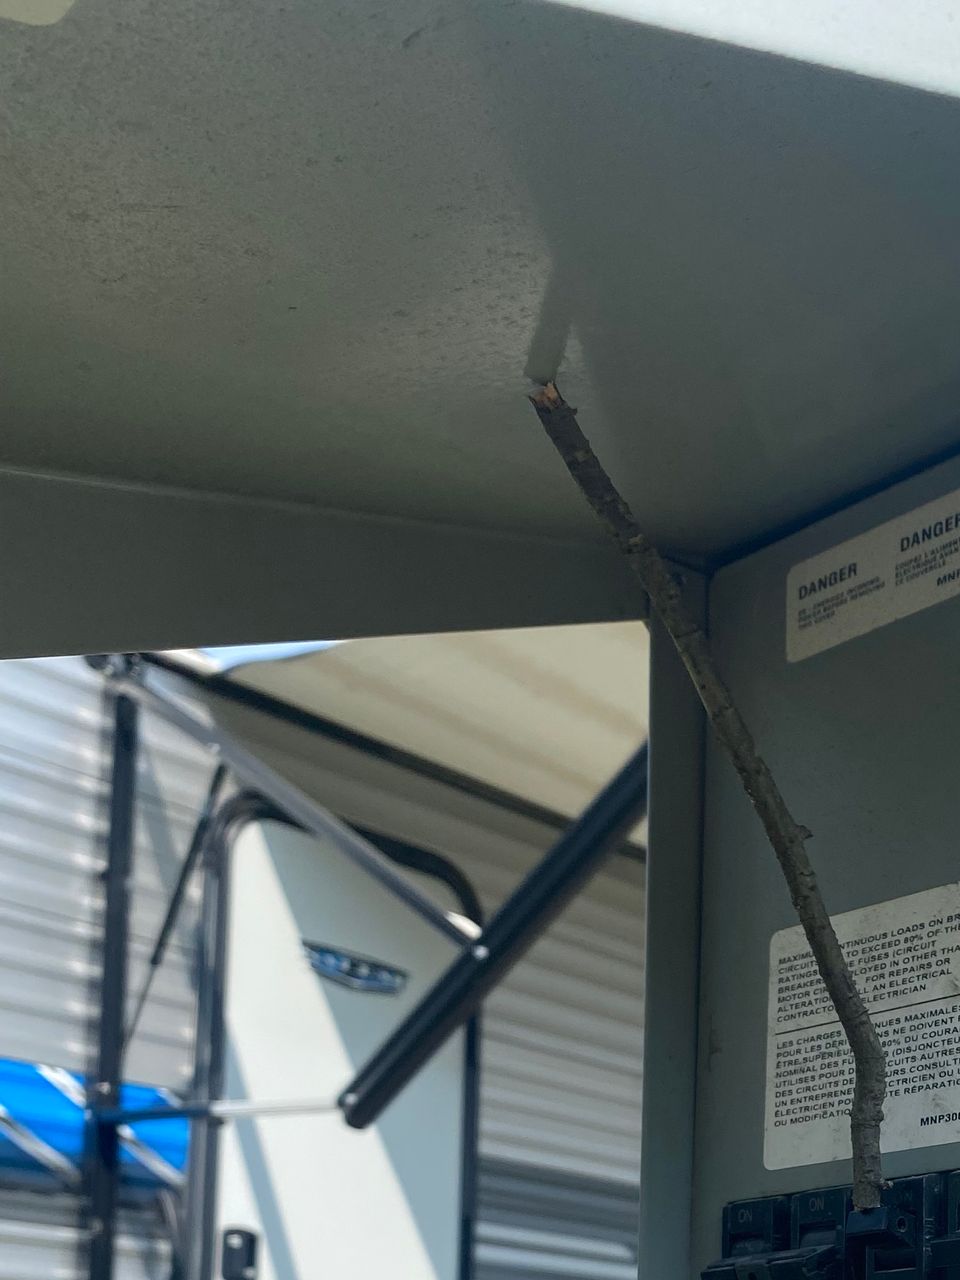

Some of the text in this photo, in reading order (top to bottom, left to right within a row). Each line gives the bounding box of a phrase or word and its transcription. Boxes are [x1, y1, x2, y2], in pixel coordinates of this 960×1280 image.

[798, 562, 857, 600] DANGER
[778, 951, 812, 963] MAXIMU
[840, 933, 887, 948] NTINUOUS
[891, 923, 925, 936] LOADS
[928, 919, 942, 927] ON
[861, 940, 900, 954] EXCEED
[903, 933, 923, 943] 80%
[926, 929, 942, 937] OF
[777, 979, 821, 993] BREAKER
[902, 950, 937, 964] OTHER
[777, 957, 950, 1003] MOTOR FOR REPAIRS OR
[778, 970, 817, 983] RATINGS
[858, 952, 889, 964] FUSES
[777, 996, 828, 1012] ALTERATIO
[872, 983, 885, 991] AN
[890, 967, 952, 987] ELECTRICAL
[776, 1005, 833, 1023] CONTRACTO
[776, 1048, 801, 1058] POUR
[804, 1044, 822, 1053] LES
[892, 1027, 906, 1035] NE
[909, 1016, 954, 1033] DOIVENT
[776, 1039, 793, 1049] LES
[796, 1029, 840, 1046] CHARGES
[776, 1056, 799, 1069] ÊTRE
[881, 1038, 900, 1047] 80%
[904, 1035, 918, 1043] DU
[775, 1073, 815, 1089] UTILISES
[818, 1068, 845, 1080] POUR
[887, 1056, 916, 1068] CUITS
[920, 1046, 960, 1062] AUTRES
[775, 1063, 816, 1078] NOMINAL
[820, 1060, 838, 1069] DES
[775, 1089, 792, 1098] DES
[795, 1079, 838, 1095] CIRCUITS
[790, 1085, 852, 1107] ENTREPRENE
[888, 1071, 935, 1089] CTRICIEN
[938, 1069, 953, 1078] OU
[774, 1096, 834, 1119] ÉLECTRICIEN
[774, 1105, 850, 1127] OU MODIFICATIO
[738, 1209, 752, 1223] ON
[809, 1198, 824, 1212] ON
